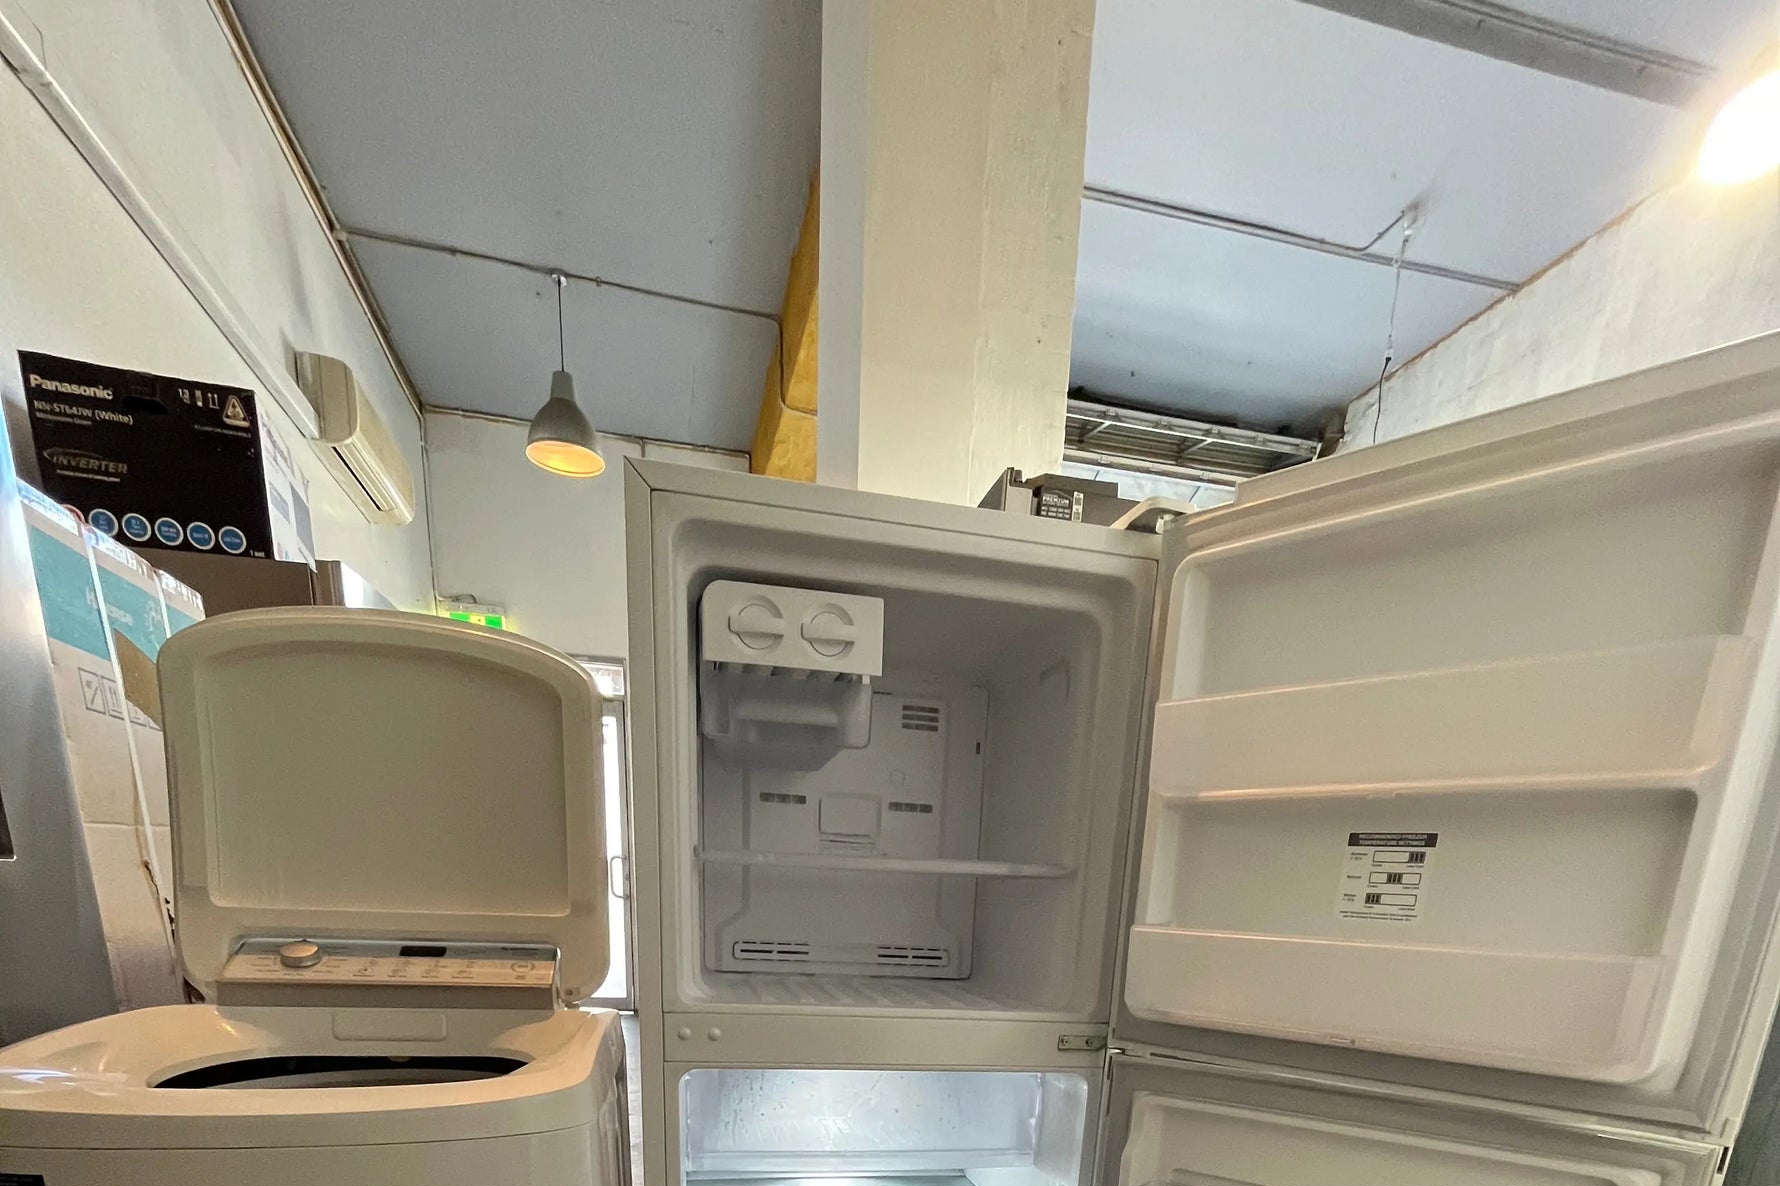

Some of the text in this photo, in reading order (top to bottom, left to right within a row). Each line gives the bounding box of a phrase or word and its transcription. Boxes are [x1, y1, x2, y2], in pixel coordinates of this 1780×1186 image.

[29, 374, 114, 400] Panasonic
[95, 409, 134, 427] (White)
[52, 453, 128, 474] INVERTER
